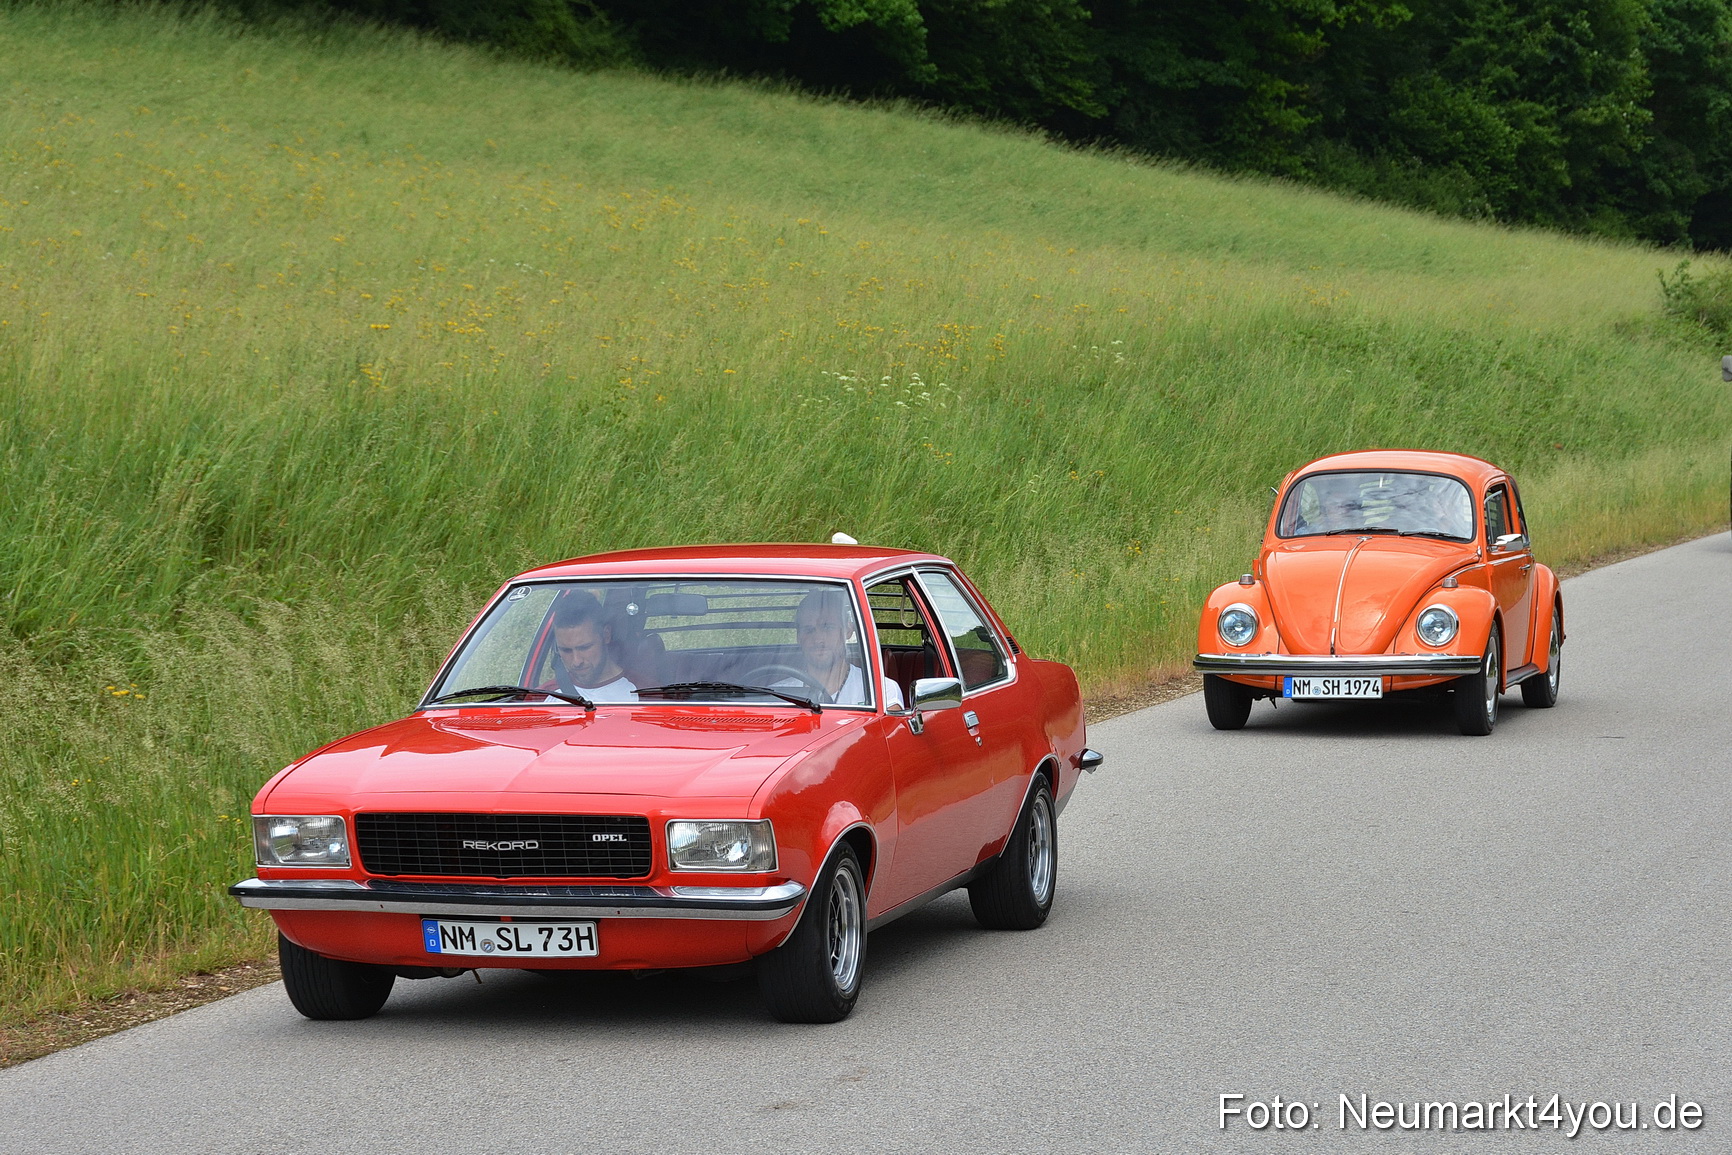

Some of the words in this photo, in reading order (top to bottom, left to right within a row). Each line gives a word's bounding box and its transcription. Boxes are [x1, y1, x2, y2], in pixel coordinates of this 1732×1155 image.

[1293, 680, 1311, 695] NM
[1322, 680, 1340, 695] SH
[1344, 680, 1380, 695] 1974
[592, 834, 627, 842] OPEL
[462, 840, 539, 851] REKORD
[429, 939, 436, 947] D
[440, 925, 477, 950] NM
[496, 927, 533, 951] SL
[538, 927, 595, 951] 73H
